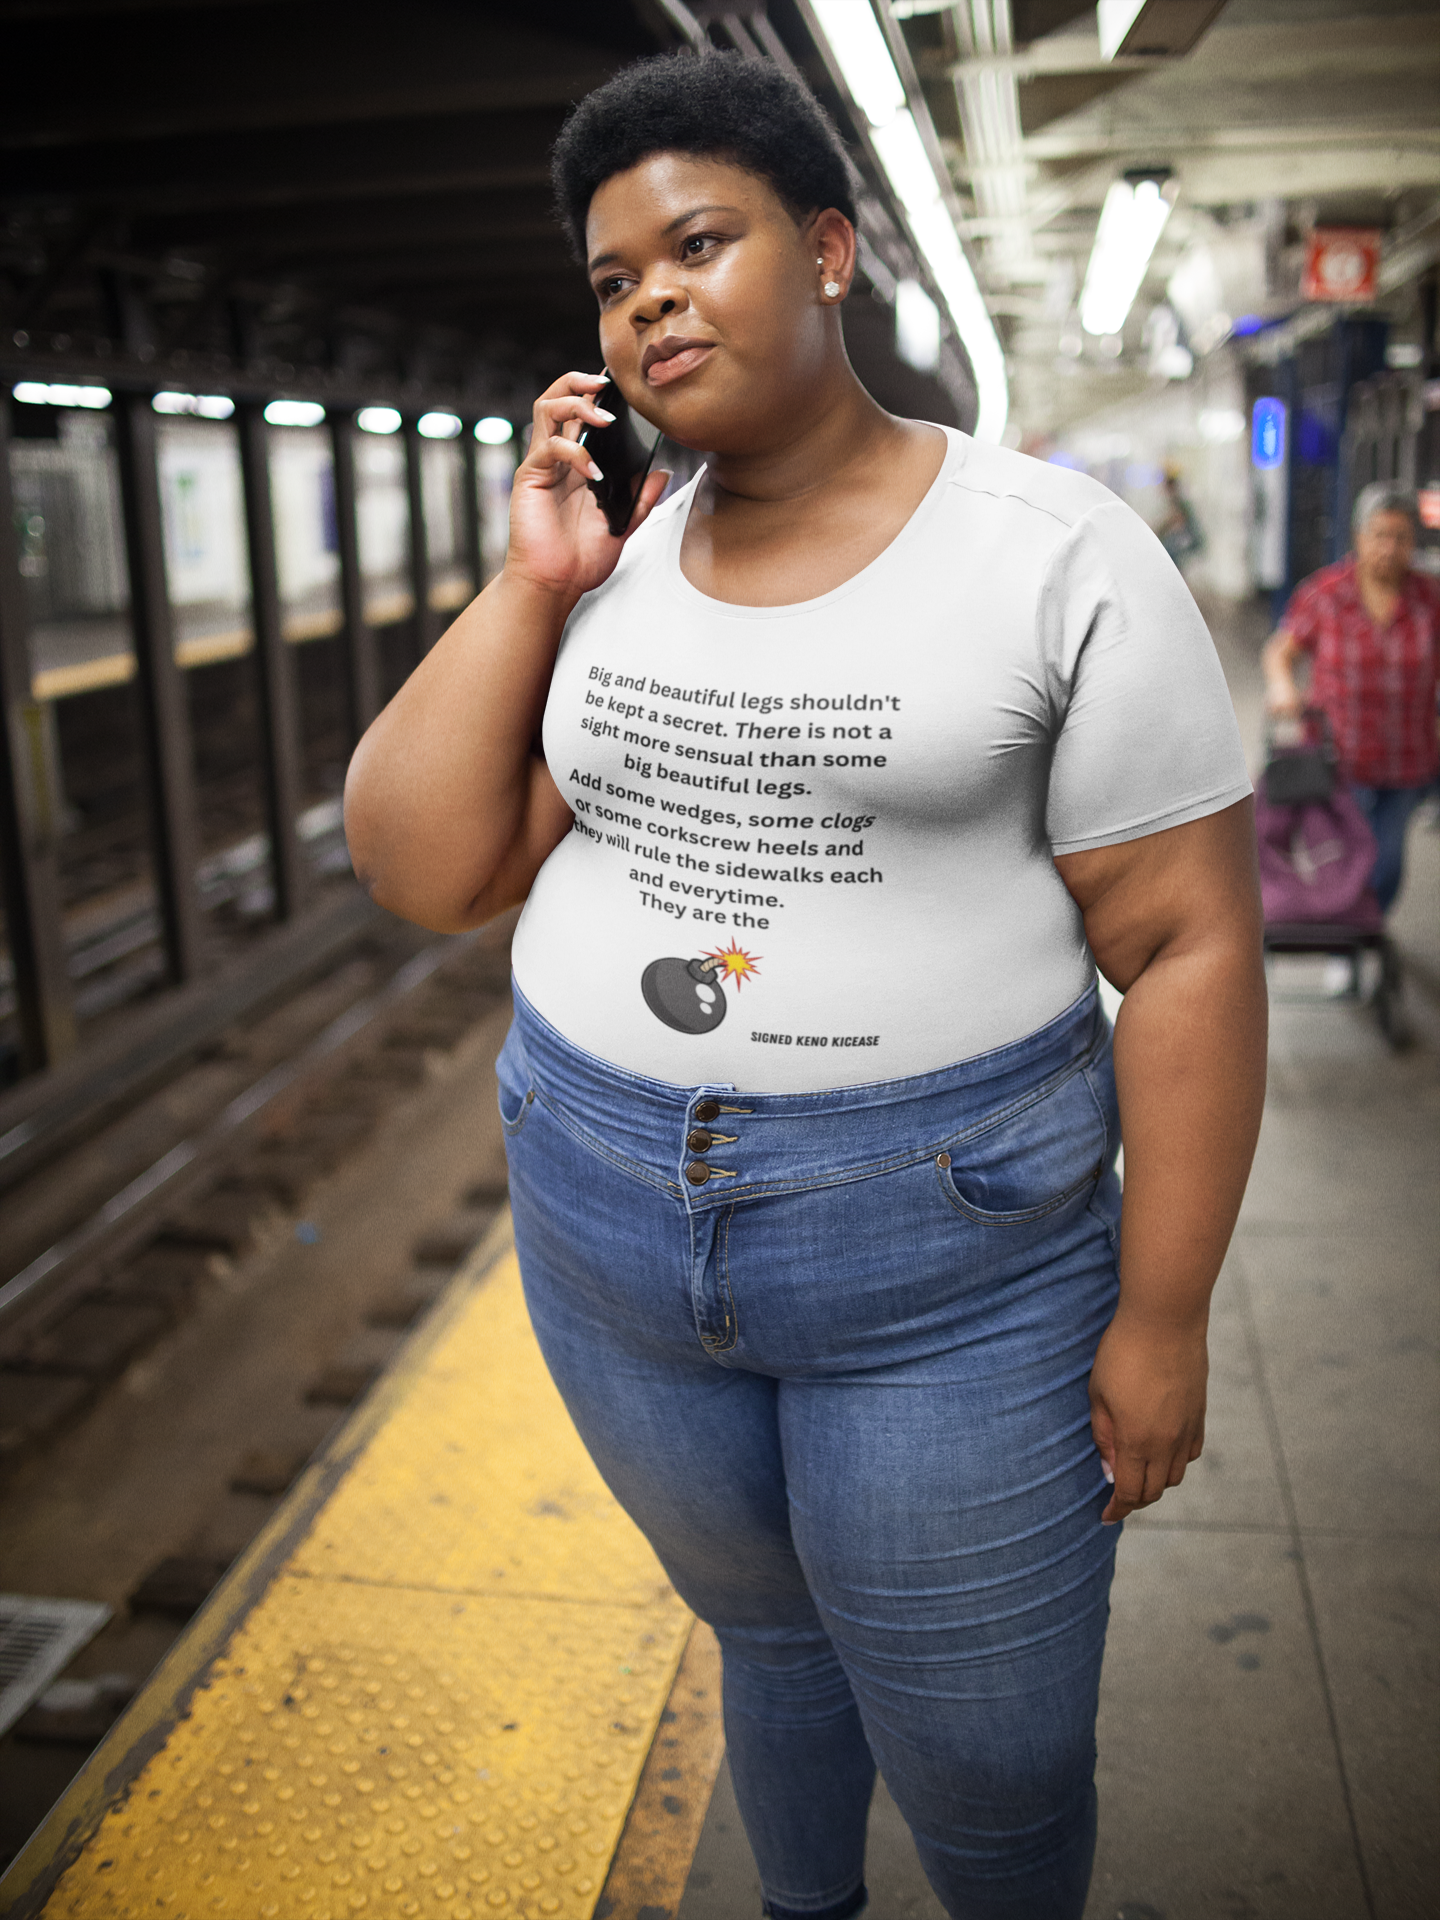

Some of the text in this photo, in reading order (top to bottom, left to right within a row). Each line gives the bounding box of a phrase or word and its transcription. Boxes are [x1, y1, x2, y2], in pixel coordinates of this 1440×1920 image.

[584, 689, 893, 740] be kept a secret. There is not a
[587, 665, 901, 715] Big and beautiful legs shouldn't
[580, 715, 888, 768] sight more sensual than some
[568, 768, 877, 833] Add some wedges, some clogs
[623, 752, 813, 800] big beautiful legs.
[574, 798, 864, 857] or some corkscrew heels and
[574, 819, 884, 884] they will rule the sidewalks each
[628, 868, 785, 909] and everytime.
[638, 889, 770, 930] They are the
[750, 1031, 881, 1048] SIGNED KENO KICEASE
